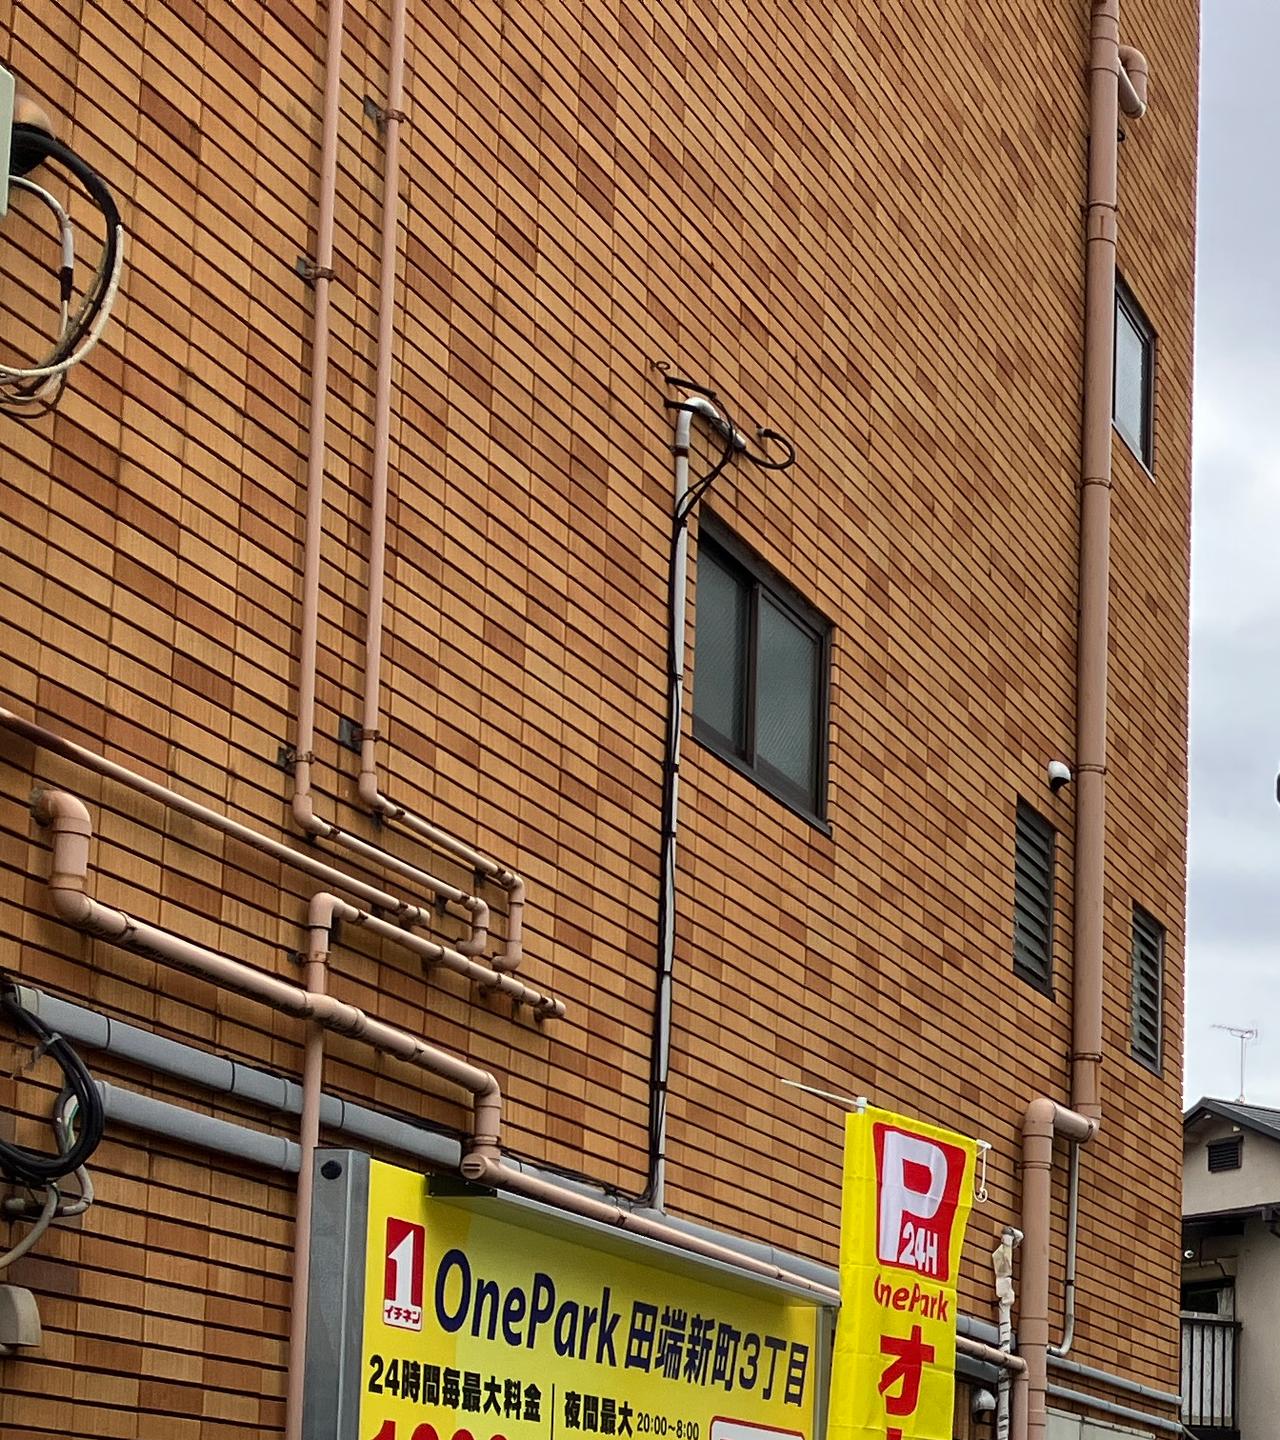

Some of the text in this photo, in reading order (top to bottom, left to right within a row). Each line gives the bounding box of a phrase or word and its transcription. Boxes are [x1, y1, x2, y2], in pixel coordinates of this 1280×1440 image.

[879, 1130, 948, 1263] P
[899, 1222, 938, 1275] 24H
[385, 1306, 421, 1325] イチネン
[435, 1249, 809, 1408] OnePark 田端新町3丁目
[368, 1354, 542, 1423] 24時間毎最大料金
[565, 1391, 633, 1438] 夜間最大
